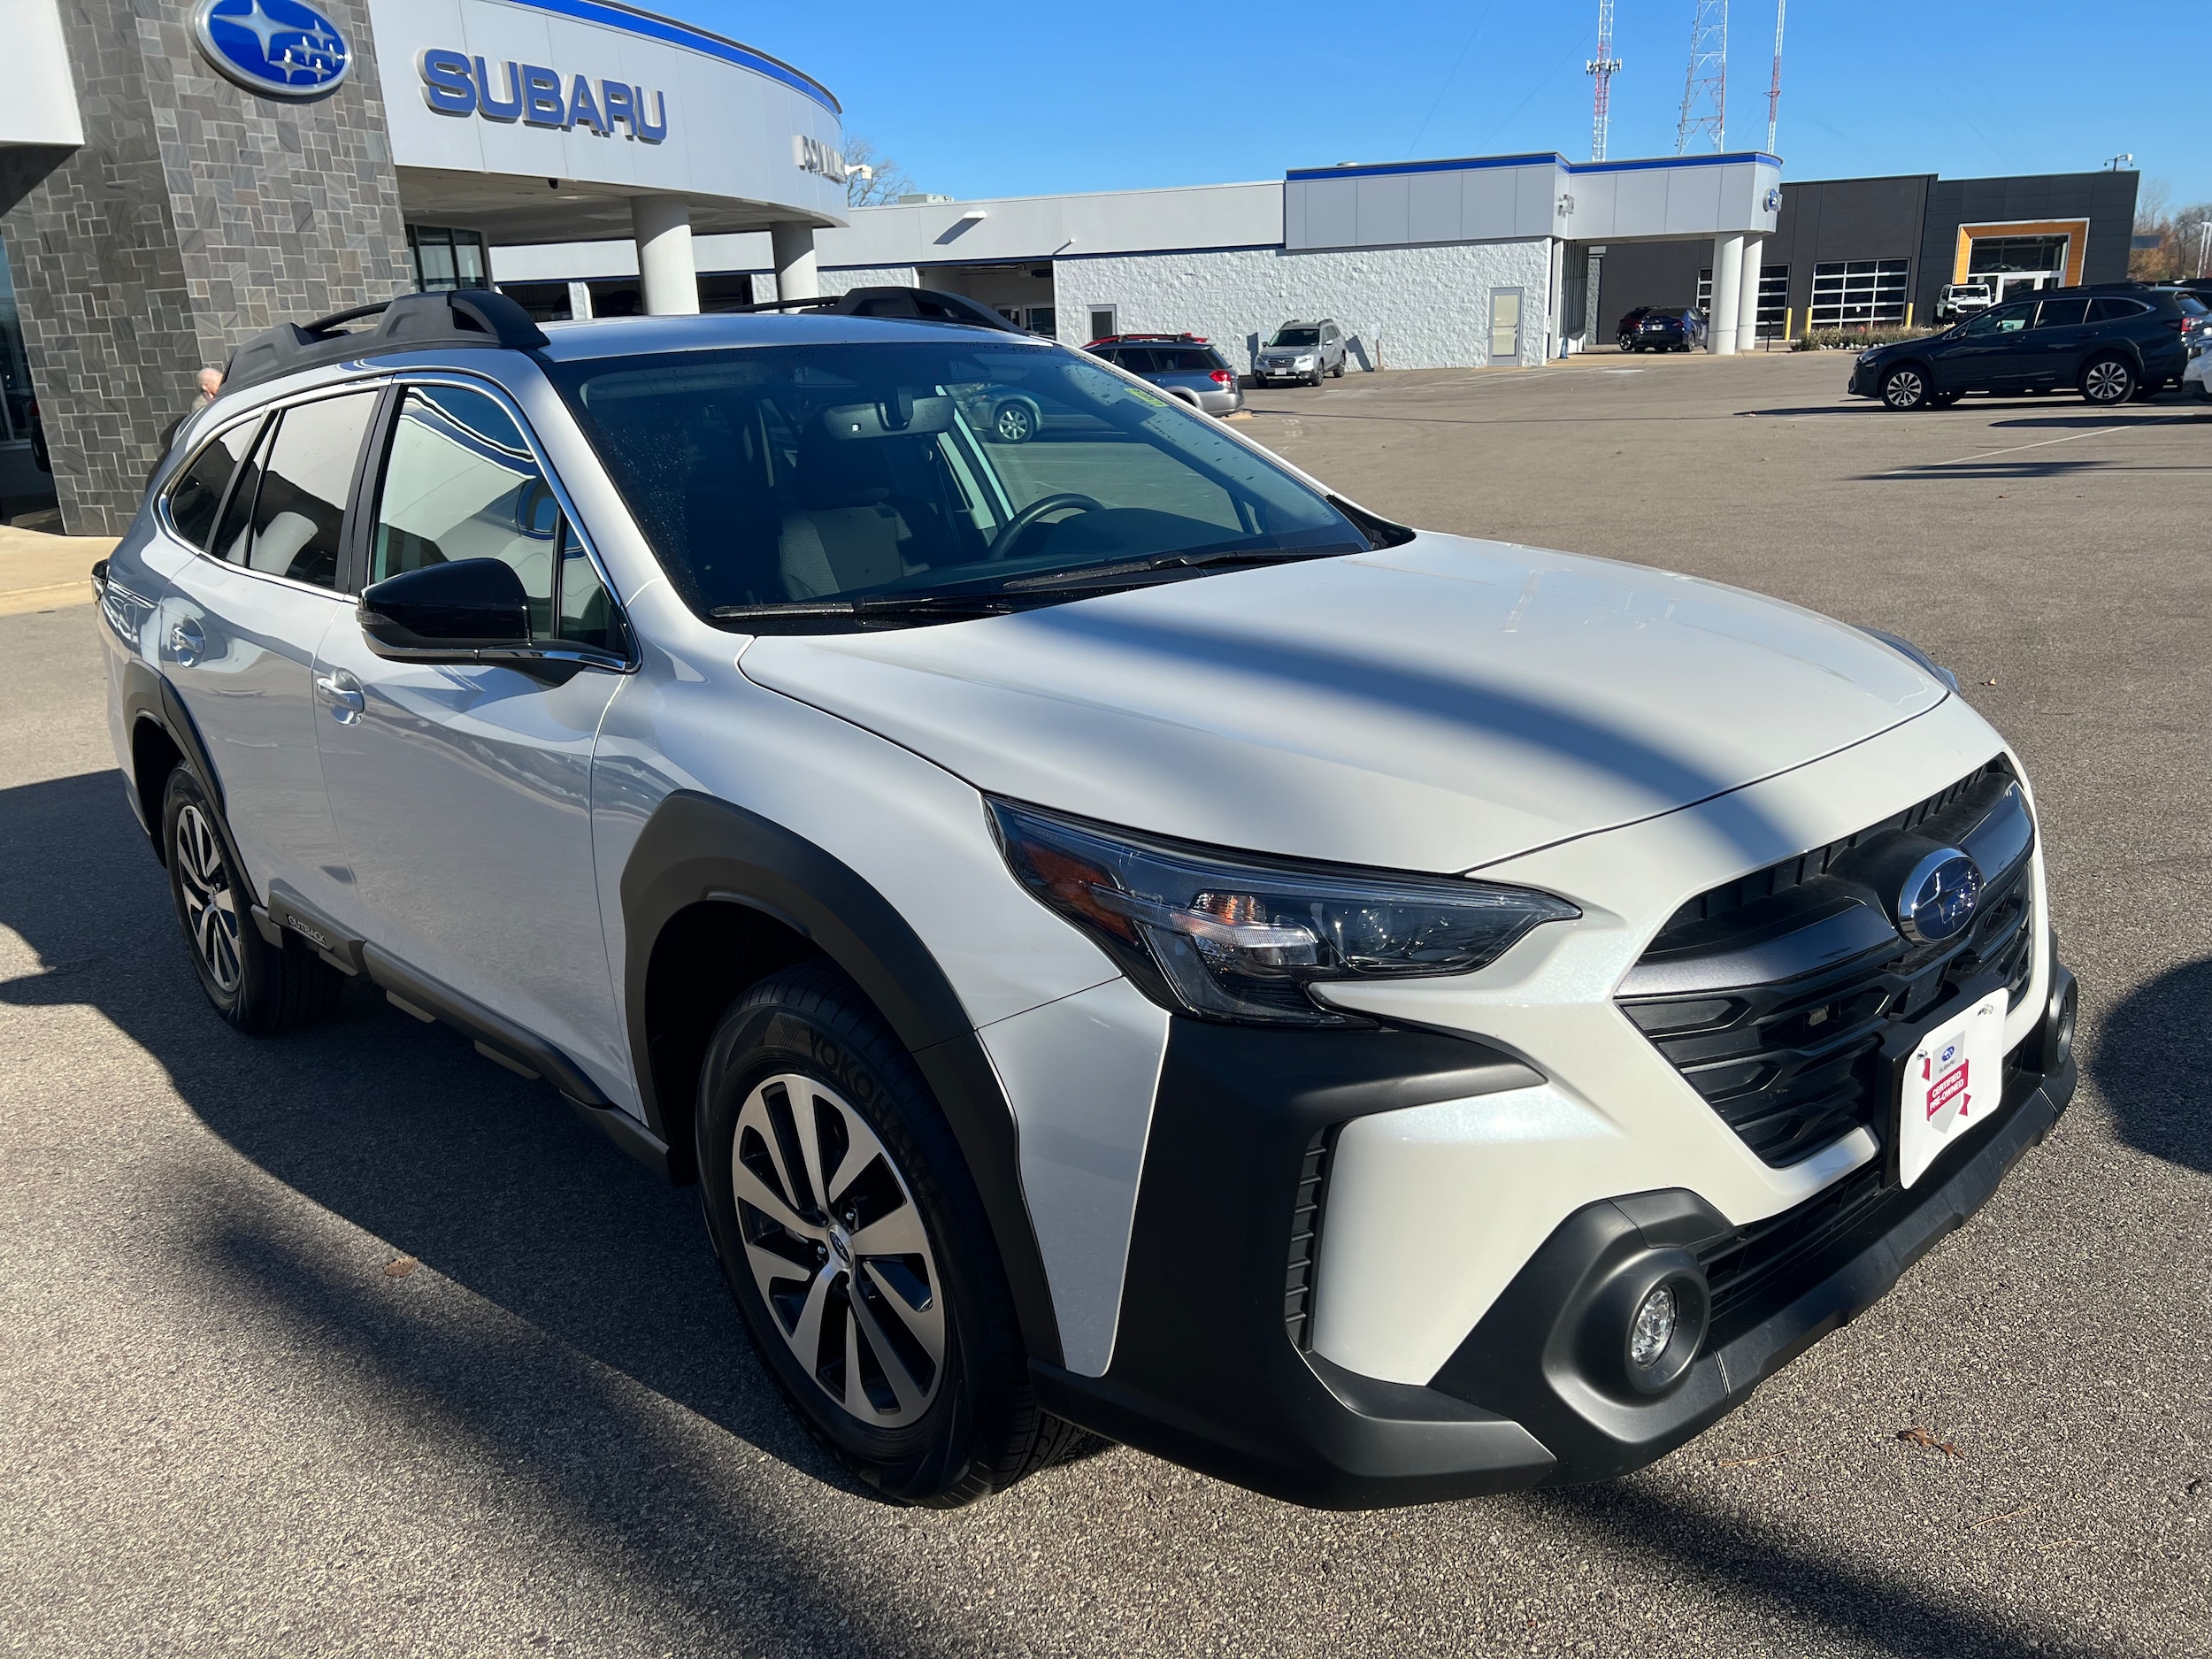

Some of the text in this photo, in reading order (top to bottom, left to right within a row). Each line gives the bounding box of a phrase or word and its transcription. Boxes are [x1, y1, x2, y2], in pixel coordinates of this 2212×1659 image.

[419, 48, 668, 142] SUBARU
[288, 915, 326, 944] OUTBACK
[1930, 1078, 1964, 1111] PRE-OWNED
[1932, 1071, 1962, 1098] CERTIFIED
